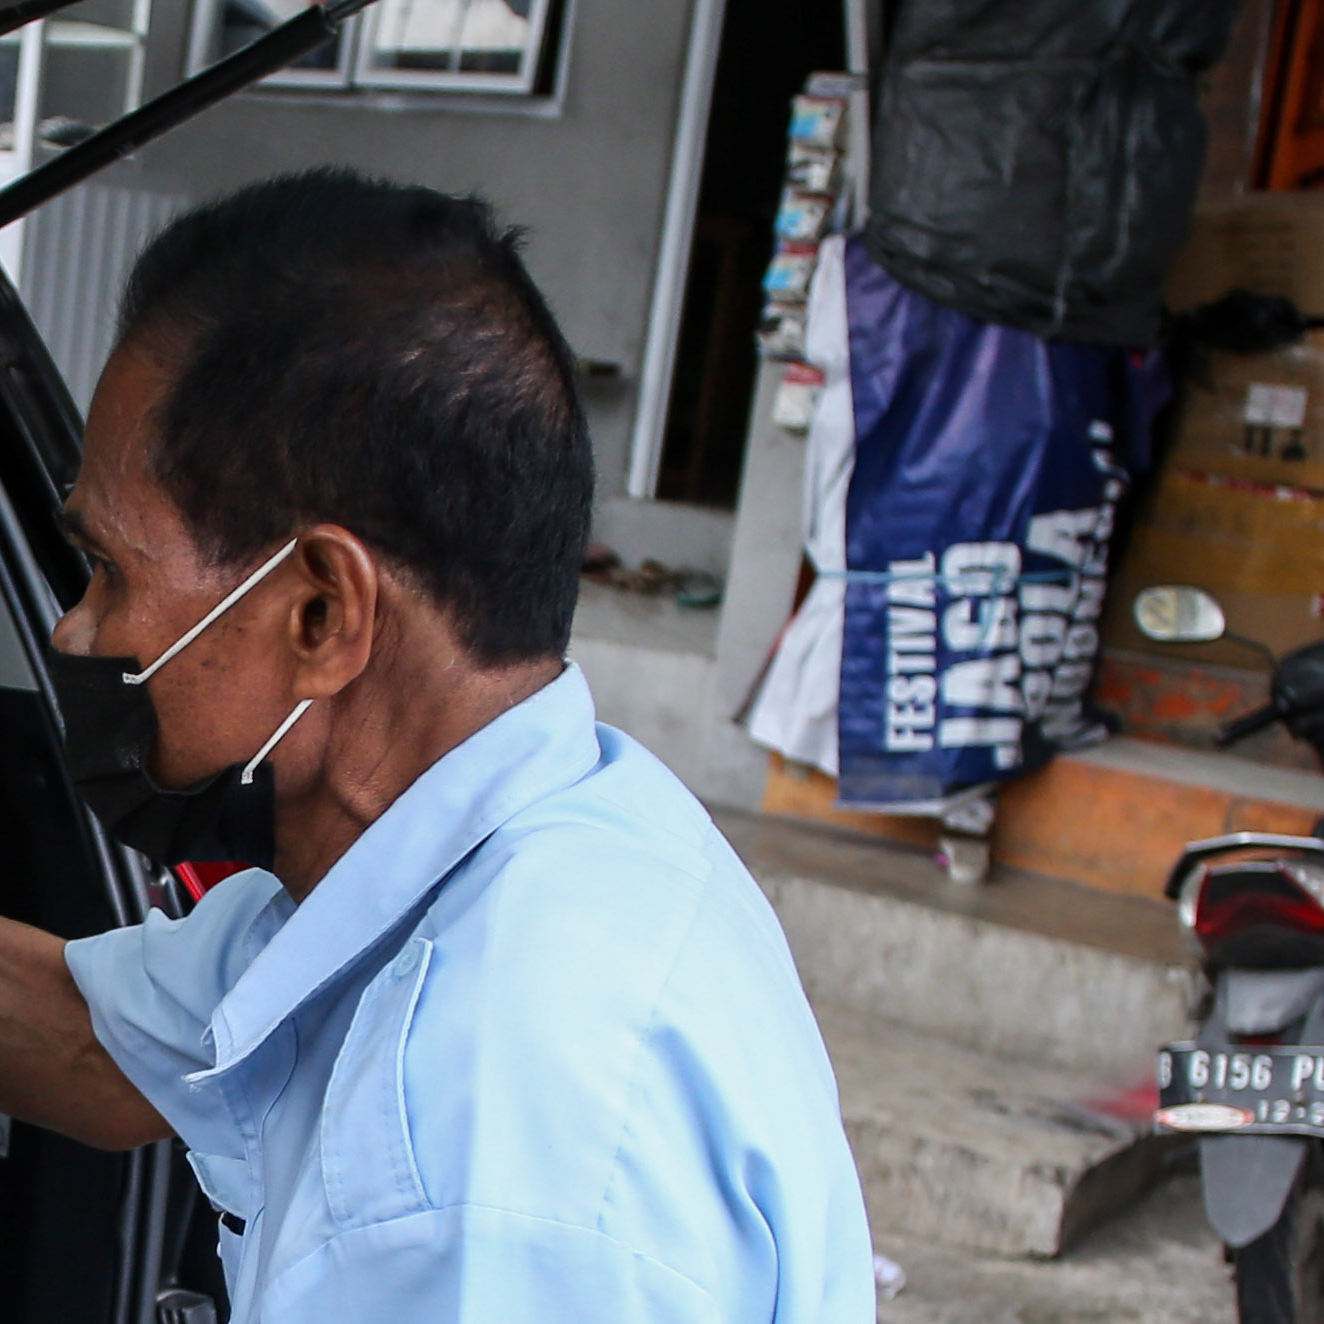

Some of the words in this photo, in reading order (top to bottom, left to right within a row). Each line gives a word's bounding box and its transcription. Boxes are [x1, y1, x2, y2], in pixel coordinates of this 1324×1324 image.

[886, 551, 936, 751] FESTIVAL
[938, 541, 1022, 769] JAGO
[1189, 1050, 1273, 1091] 6156
